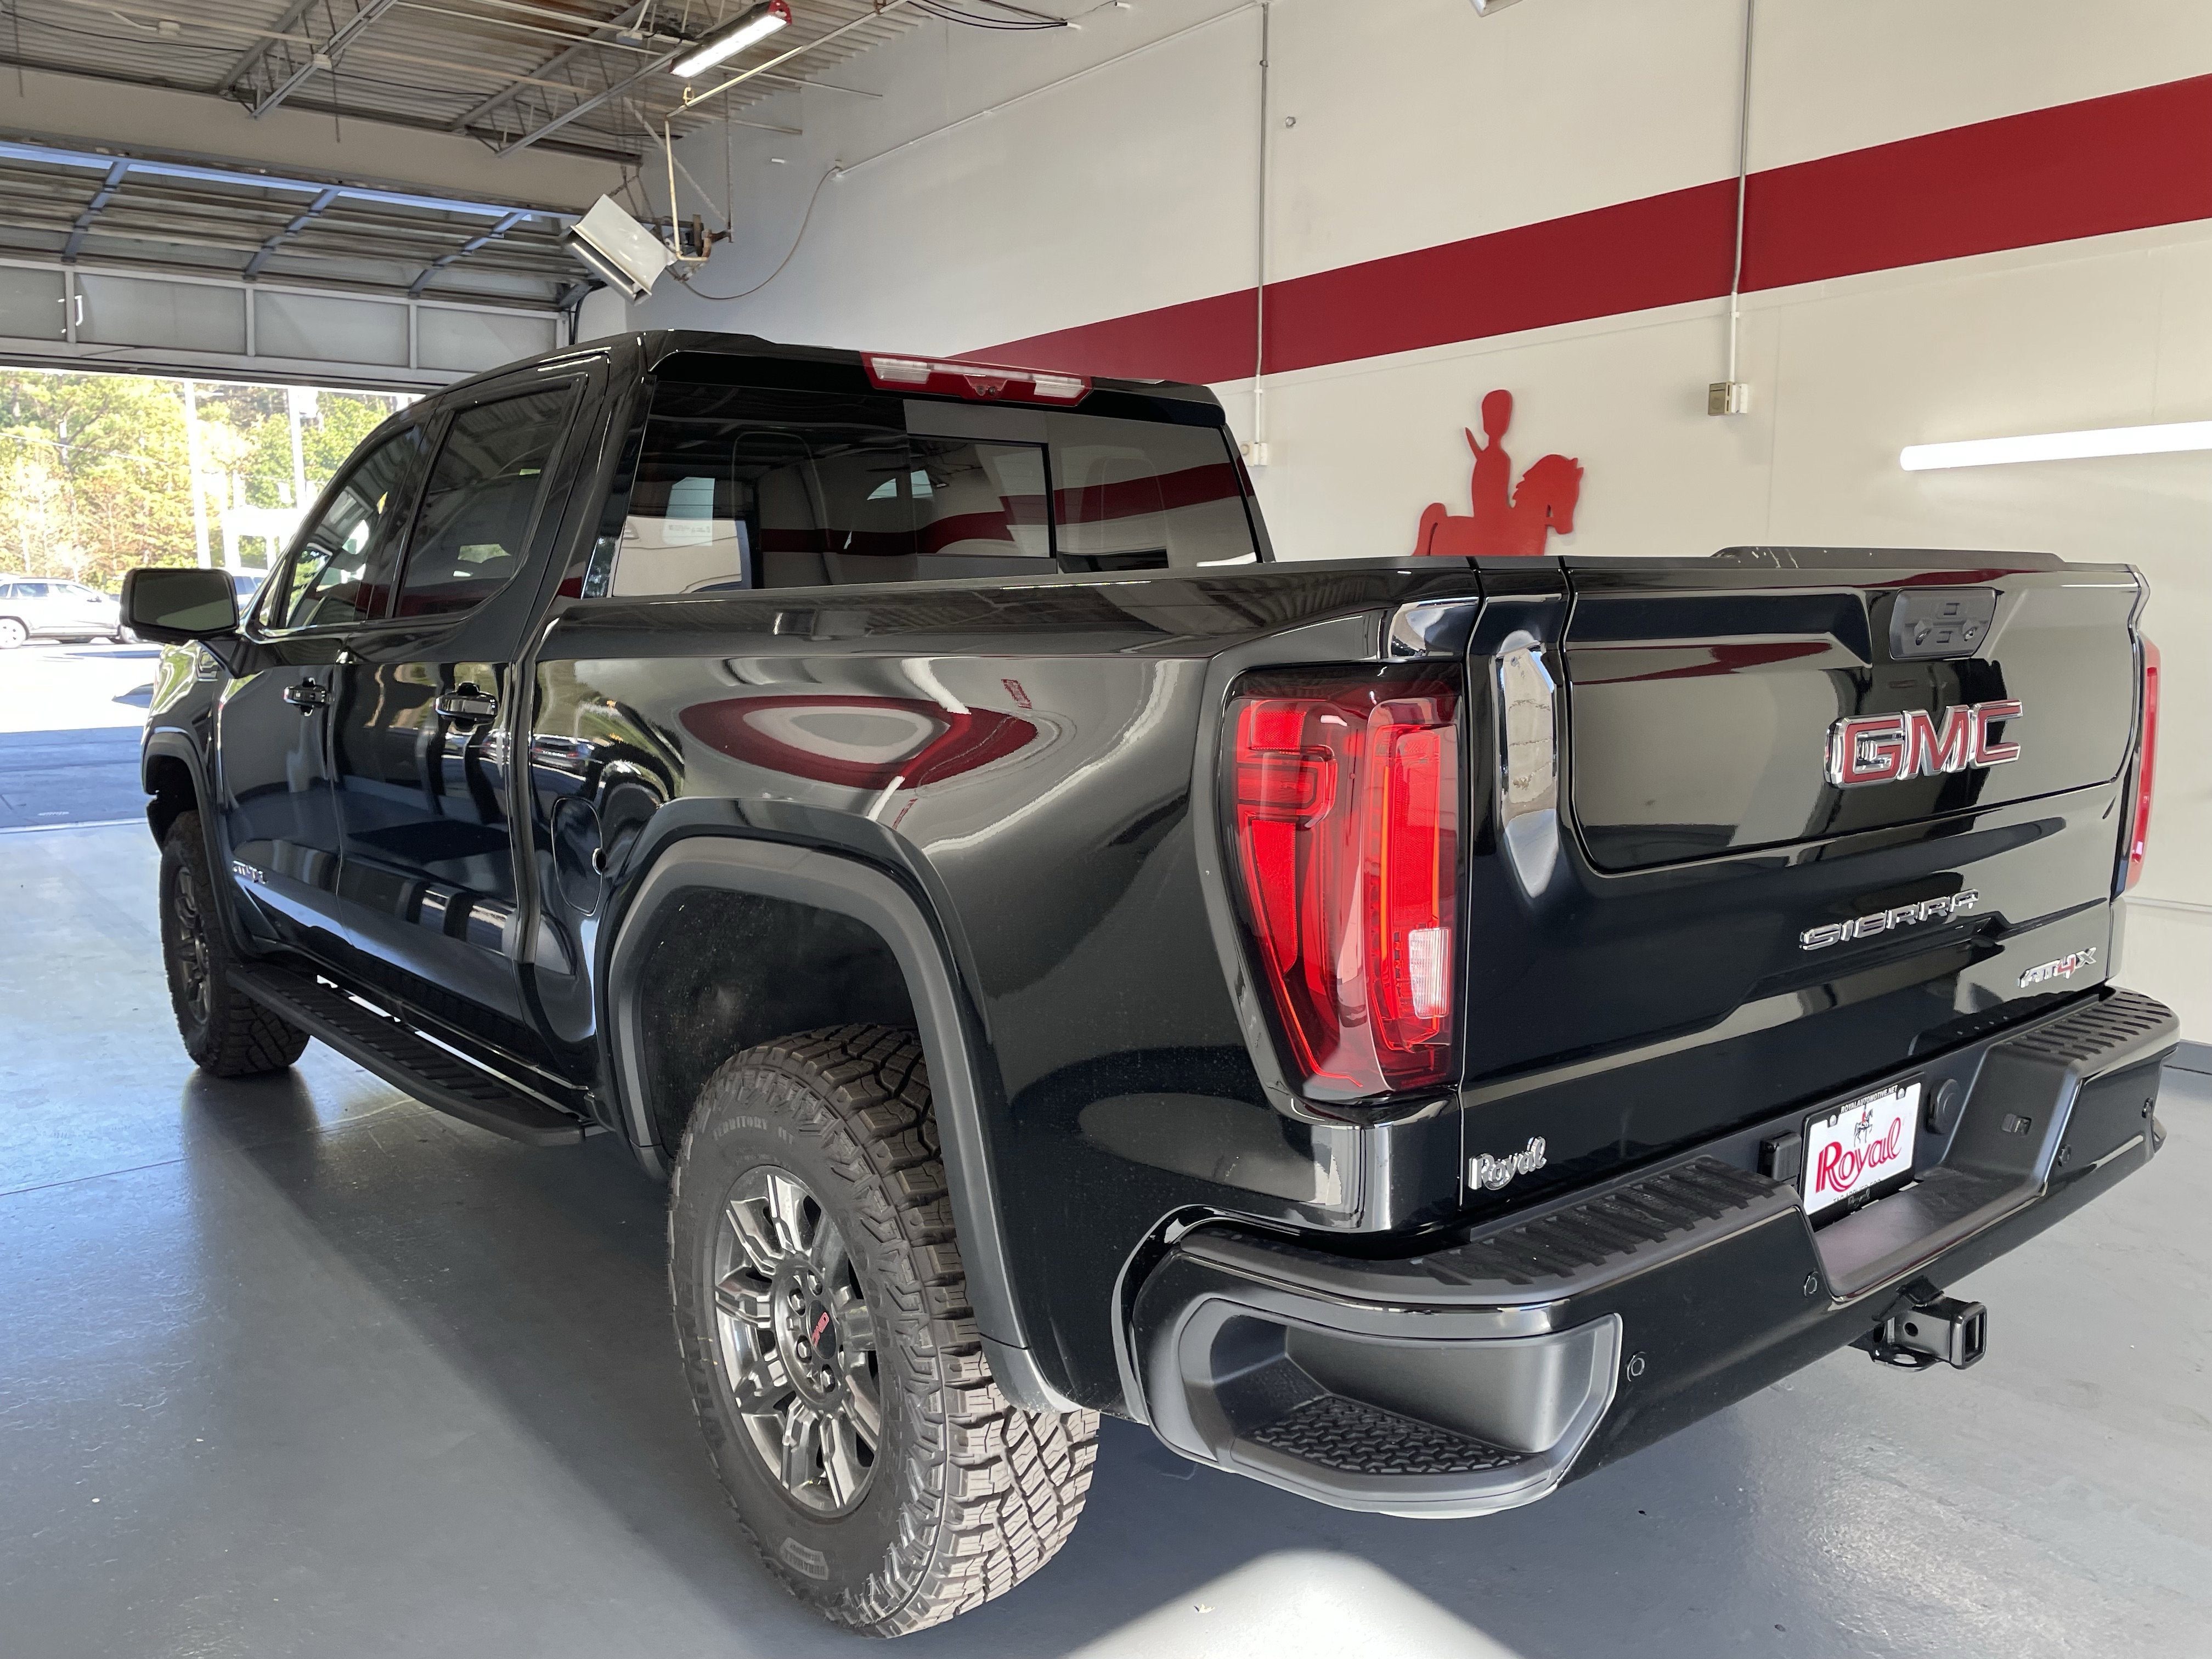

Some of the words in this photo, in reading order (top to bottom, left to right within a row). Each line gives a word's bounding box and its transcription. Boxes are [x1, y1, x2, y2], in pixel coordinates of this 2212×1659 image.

[1824, 699, 2023, 789] GMC
[1799, 889, 1979, 950] SIERRA
[2017, 947, 2097, 989] AT4X
[1840, 1085, 1898, 1114] ROYALAUTOMOTIVE.NET
[1468, 1136, 1547, 1190] Royal
[1815, 1117, 1902, 1194] Royal
